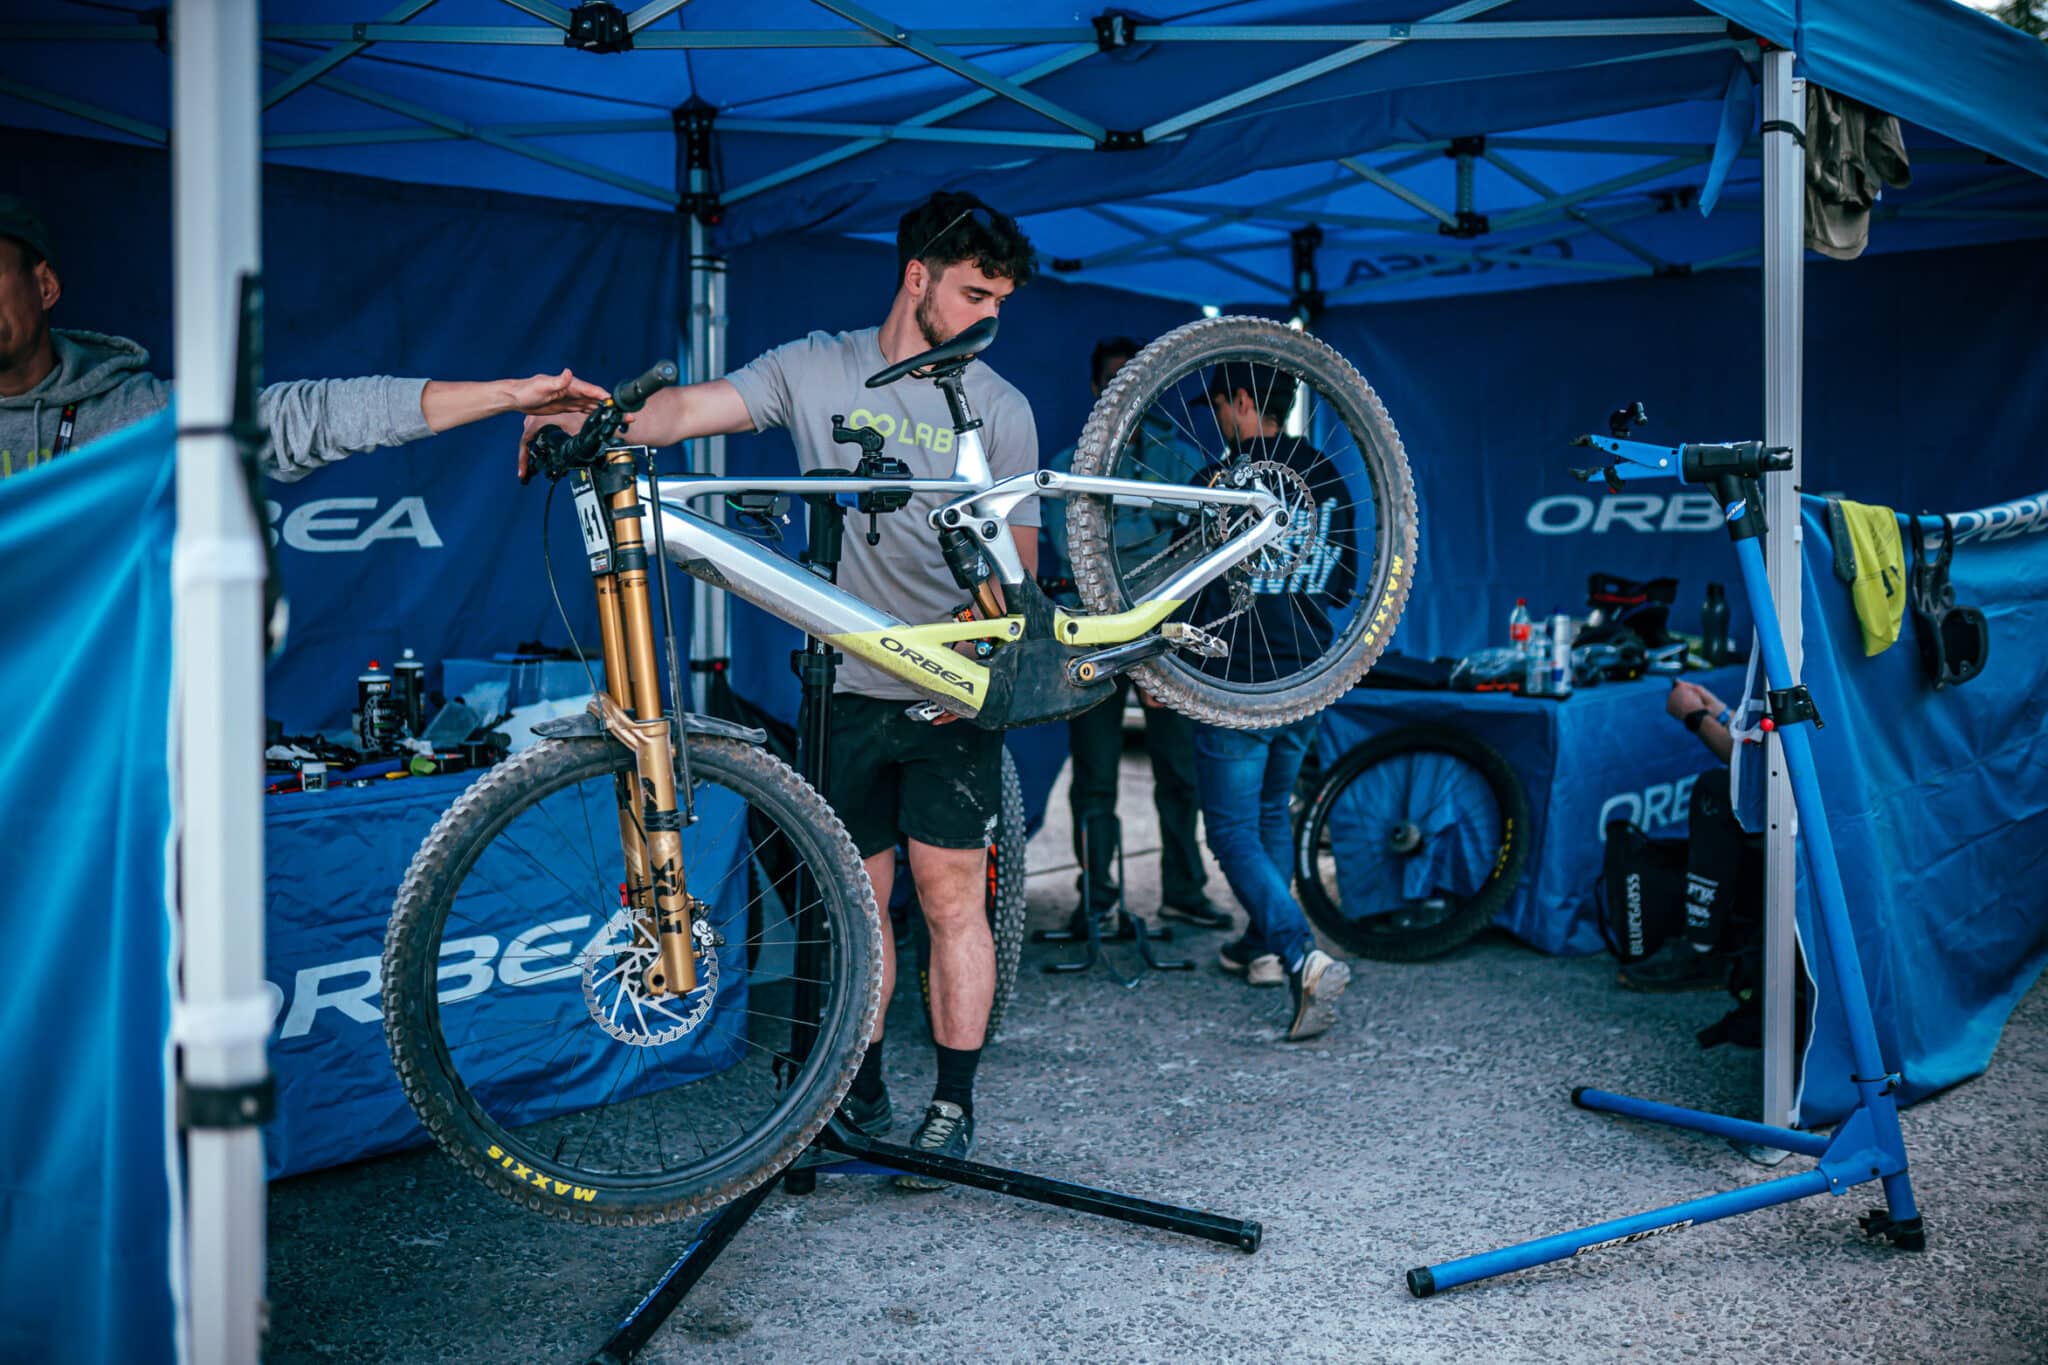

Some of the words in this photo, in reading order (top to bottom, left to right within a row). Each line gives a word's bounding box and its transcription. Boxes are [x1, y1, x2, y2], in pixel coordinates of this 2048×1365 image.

[898, 418, 954, 453] LAB
[1364, 555, 1404, 646] MAXXIS
[880, 636, 975, 696] ORBEA
[487, 1145, 598, 1203] MAXXIS
